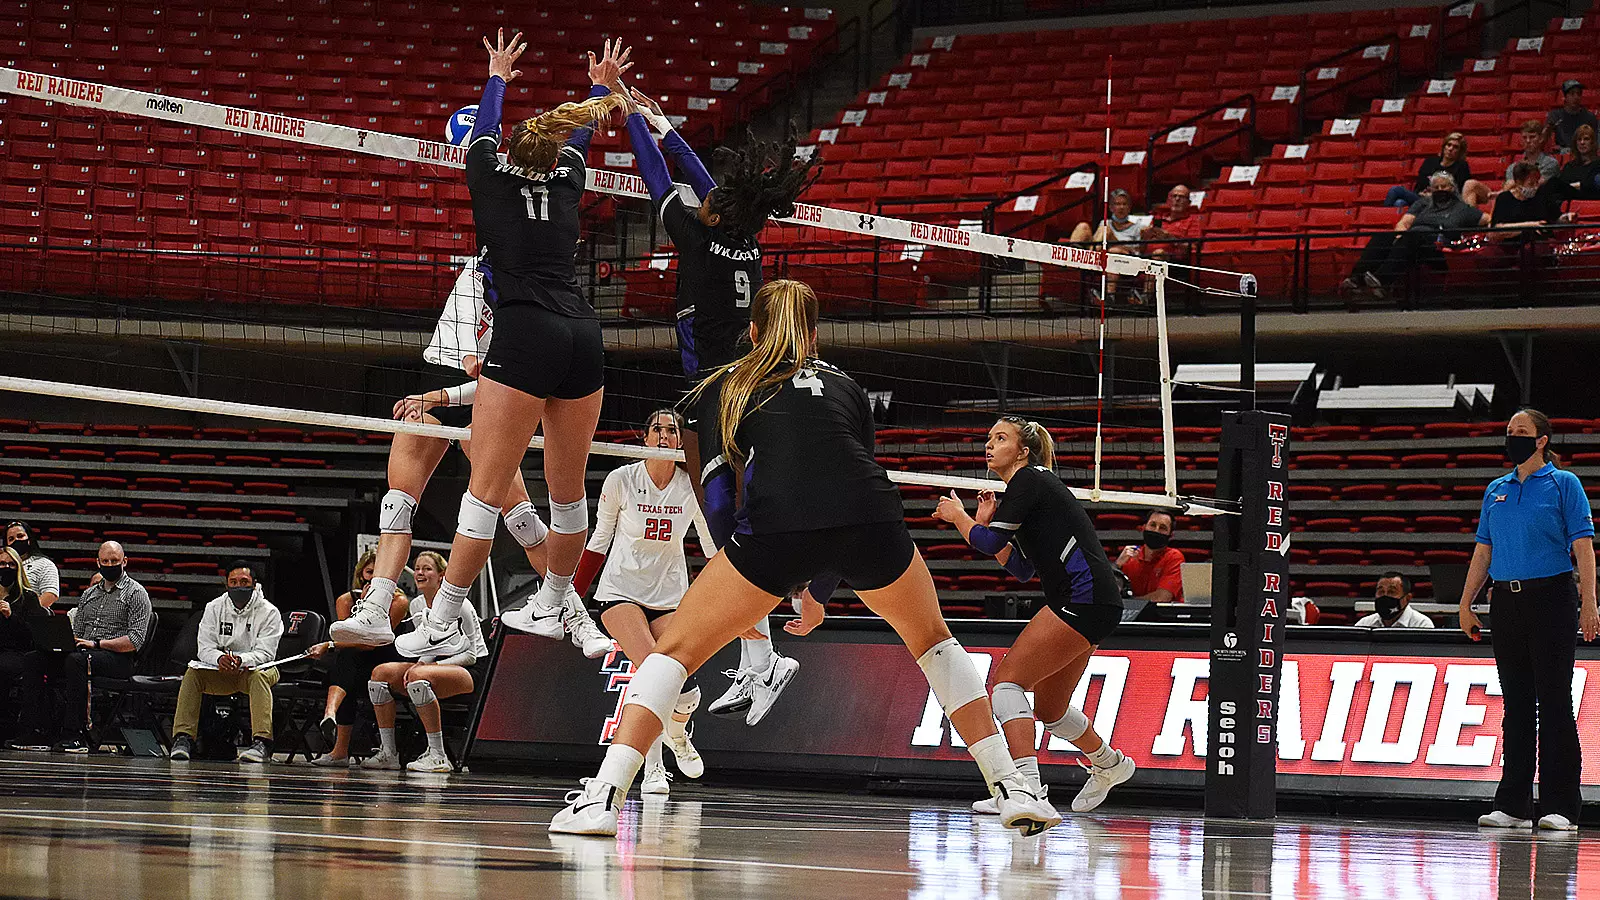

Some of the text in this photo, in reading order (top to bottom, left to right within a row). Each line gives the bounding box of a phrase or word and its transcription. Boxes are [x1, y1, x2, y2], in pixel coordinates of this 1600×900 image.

[17, 71, 104, 103] RED RAIDERS
[146, 98, 184, 115] molten
[225, 108, 306, 138] RED RAIDERS
[417, 141, 440, 160] RED
[594, 170, 616, 189] RED
[520, 184, 549, 221] 17
[910, 222, 970, 247] RED RAIDERS
[1051, 245, 1068, 261] RED
[734, 269, 751, 308] 9
[792, 366, 824, 397] 4
[637, 503, 683, 515] TEXAS TECH
[1264, 480, 1284, 552] RED
[643, 517, 673, 542] 22
[1256, 572, 1281, 744] RAIDERS
